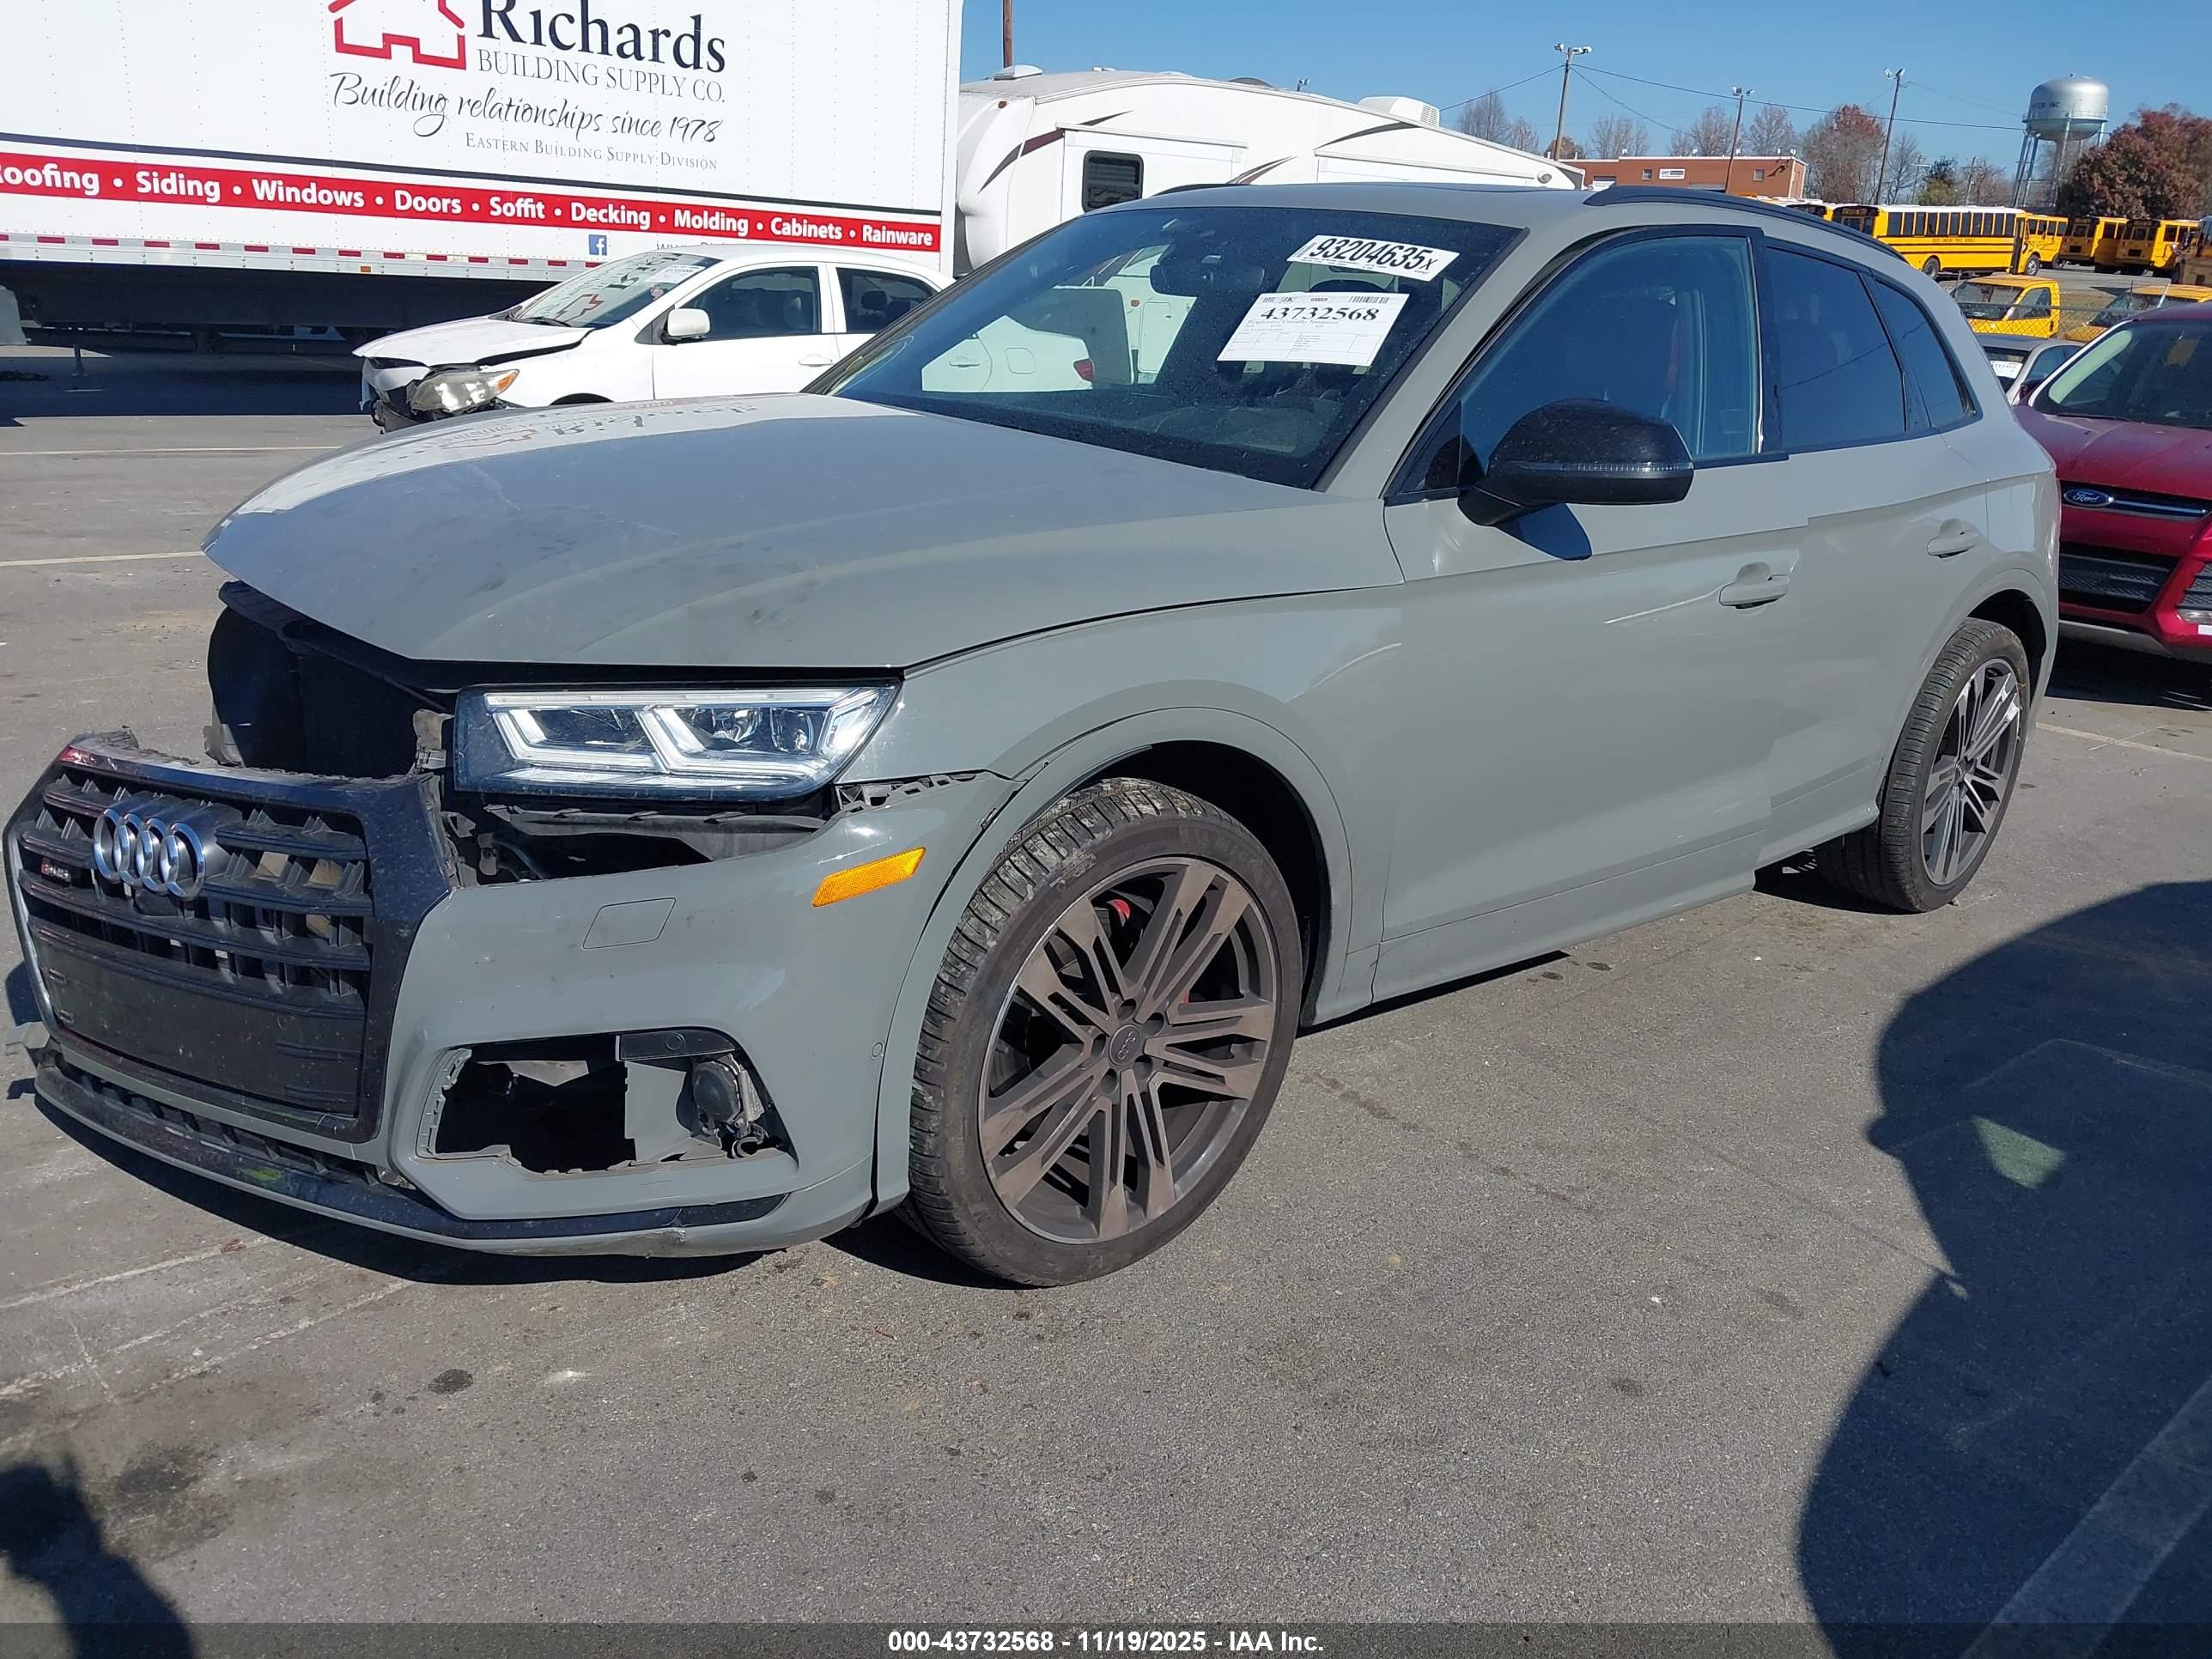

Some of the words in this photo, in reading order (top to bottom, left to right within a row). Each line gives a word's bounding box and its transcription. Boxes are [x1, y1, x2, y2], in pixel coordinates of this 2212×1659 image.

[477, 0, 726, 73] Richards
[477, 48, 600, 87] BUILDING
[605, 65, 687, 98] SUPPLY
[693, 78, 725, 103] CO.
[330, 72, 450, 137] Building
[457, 87, 604, 143] relationships
[611, 109, 663, 137] since
[669, 116, 724, 143] 1978
[465, 132, 530, 153] EASTERN
[534, 139, 603, 161] BUILDING
[606, 146, 655, 165] SUPPLY
[660, 151, 718, 171] DIVISION
[136, 171, 222, 204] Siding
[252, 178, 365, 208] Windows
[394, 190, 462, 215] Doors
[489, 196, 545, 220] Soffit
[570, 202, 651, 230] Decking
[674, 209, 749, 237] Molding
[770, 217, 843, 240] Cabinets
[862, 225, 933, 247] Rainware
[1261, 307, 1380, 321] 43732568
